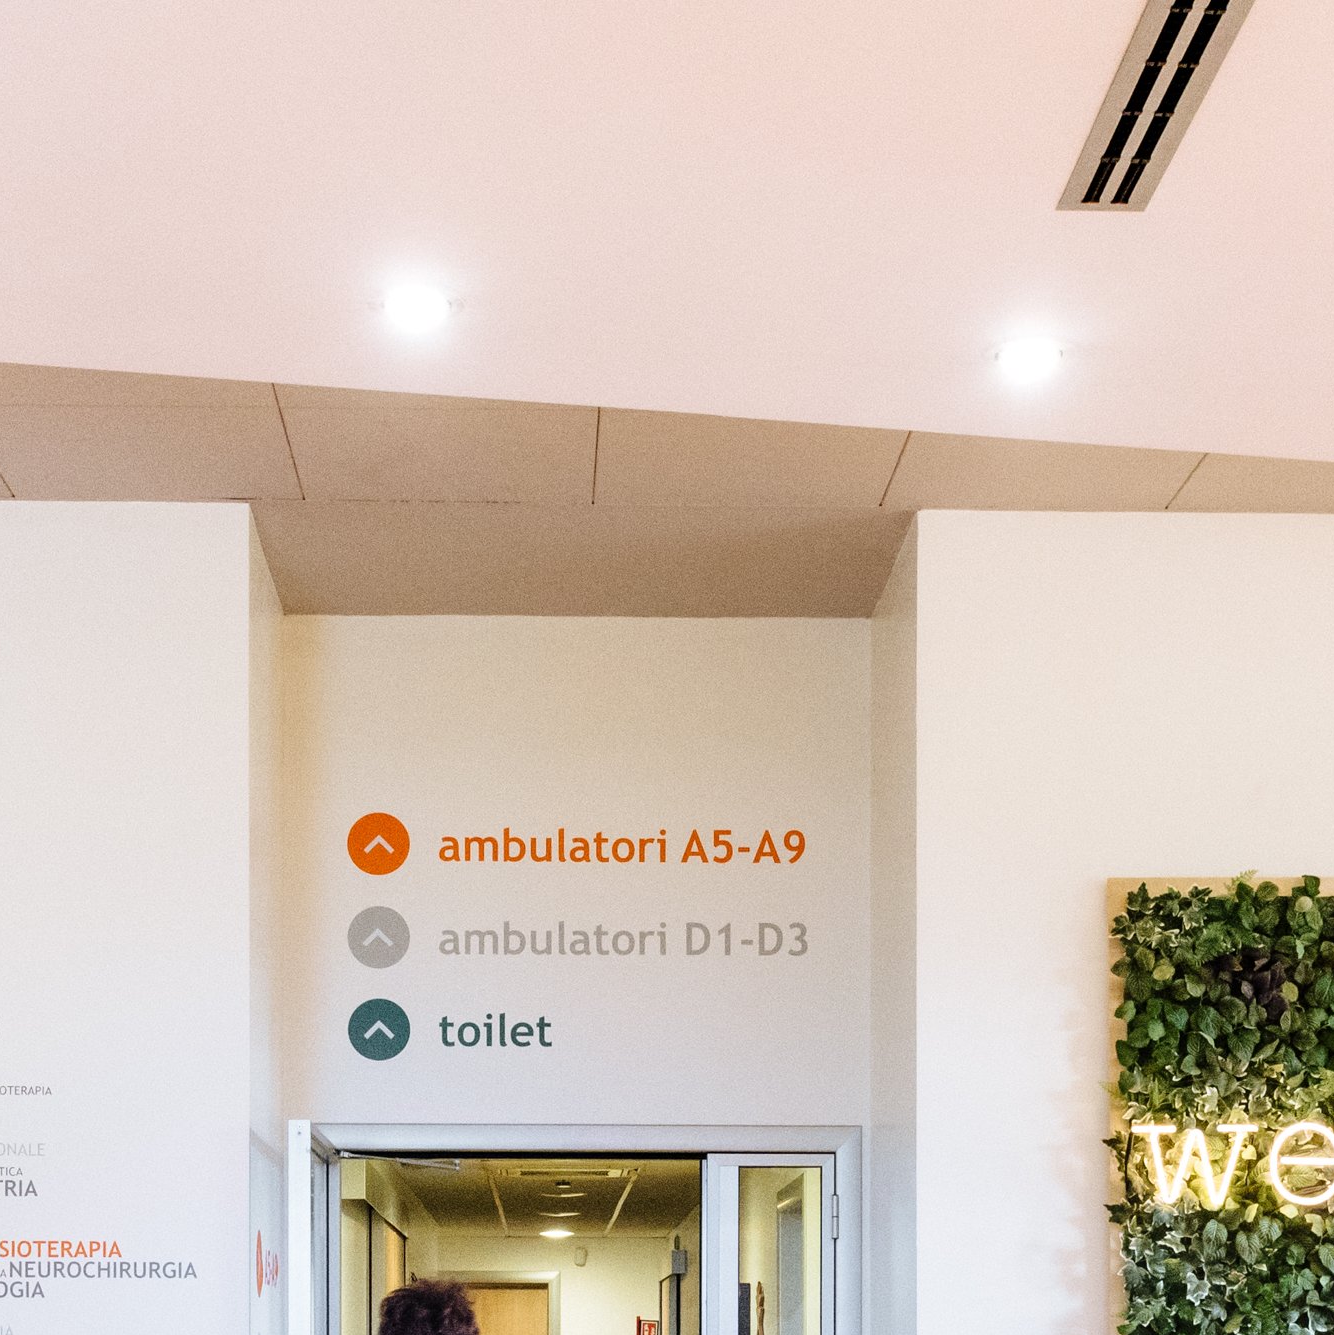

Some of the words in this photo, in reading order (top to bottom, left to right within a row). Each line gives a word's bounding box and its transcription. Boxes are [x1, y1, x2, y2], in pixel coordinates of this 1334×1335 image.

[438, 827, 667, 863] ambulatori
[681, 829, 806, 864] A5-A9
[438, 920, 667, 956] ambulatori
[685, 922, 808, 957] D1-D3
[439, 1013, 553, 1047] toilet
[10, 1262, 197, 1279] NEUROCHIRURGIA
